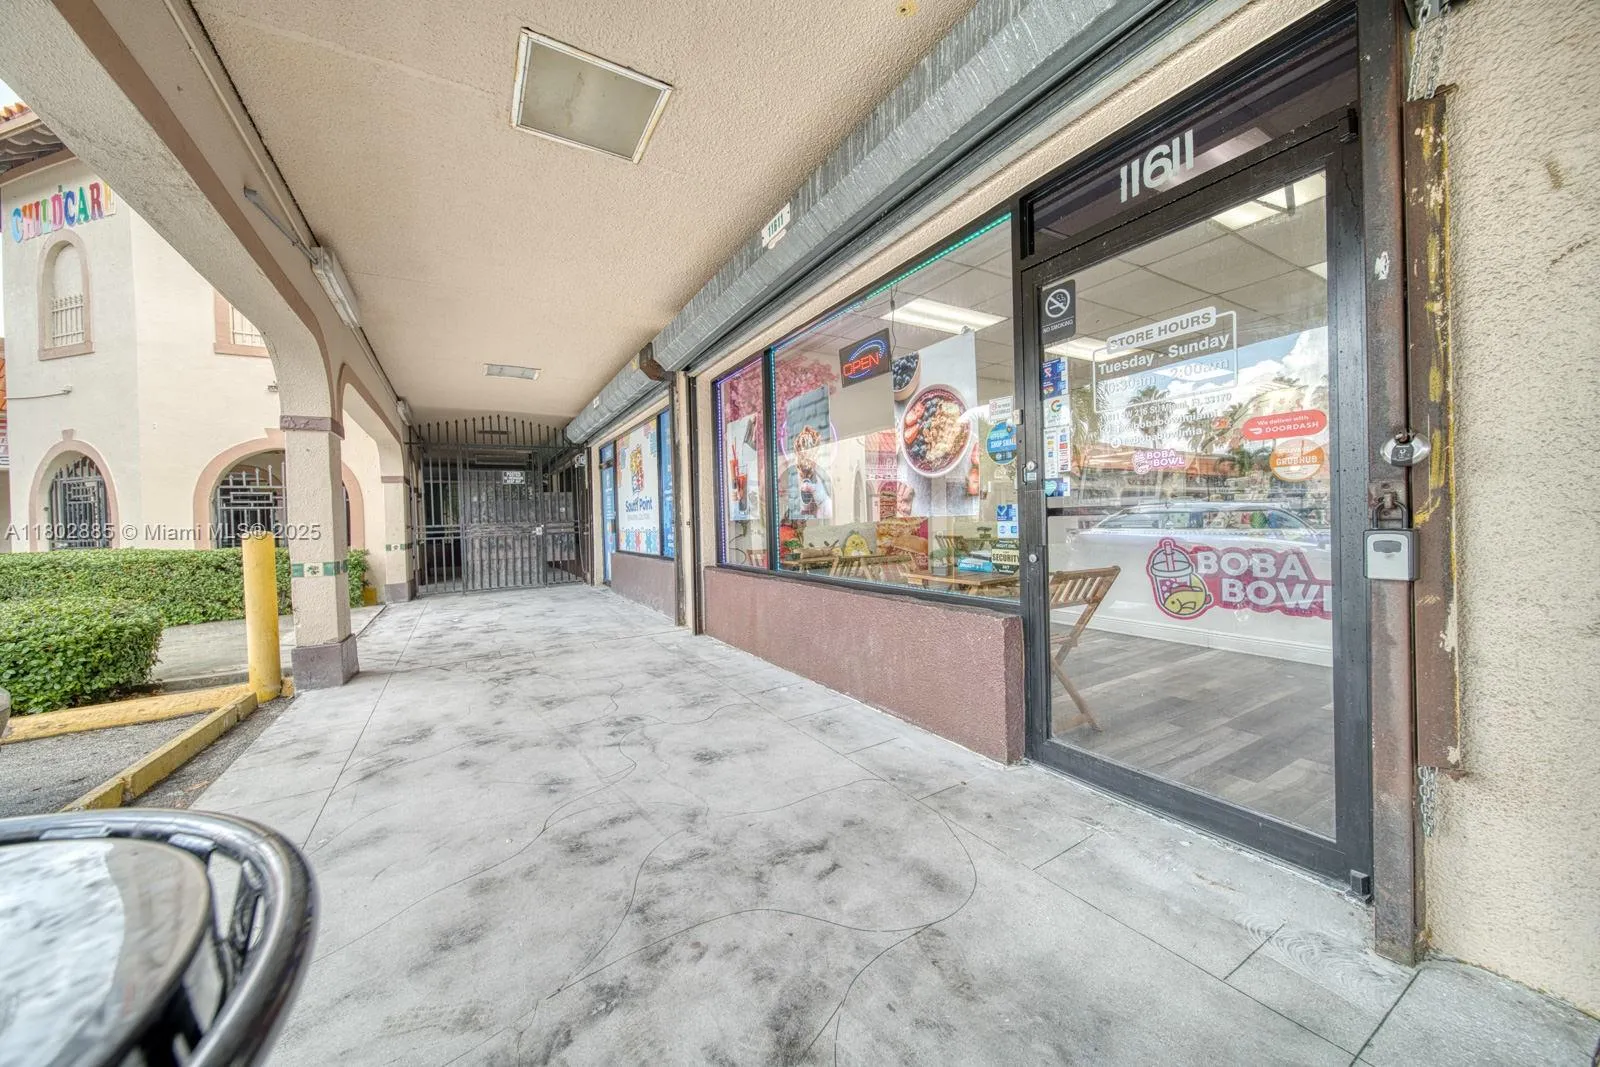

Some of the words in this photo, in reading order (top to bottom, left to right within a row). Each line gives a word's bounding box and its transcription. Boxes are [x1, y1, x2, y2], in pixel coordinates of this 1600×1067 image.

[1121, 129, 1193, 203] 11611
[768, 212, 783, 237] 11611
[1051, 319, 1073, 331] SMOKING
[1110, 329, 1154, 350] STORE
[1158, 312, 1211, 336] HOURS
[1098, 353, 1155, 375] Tuesday
[1168, 333, 1230, 358] Sunday
[843, 352, 879, 376] OPEN
[1265, 421, 1319, 433] DOORDASH
[1269, 416, 1293, 425] deliver
[1293, 414, 1309, 422] with
[1146, 450, 1176, 460] BOBA
[1153, 457, 1185, 467] BOWL
[1275, 455, 1318, 466] GRUBHUB
[640, 496, 653, 511] Point
[1197, 551, 1308, 580] BOBA
